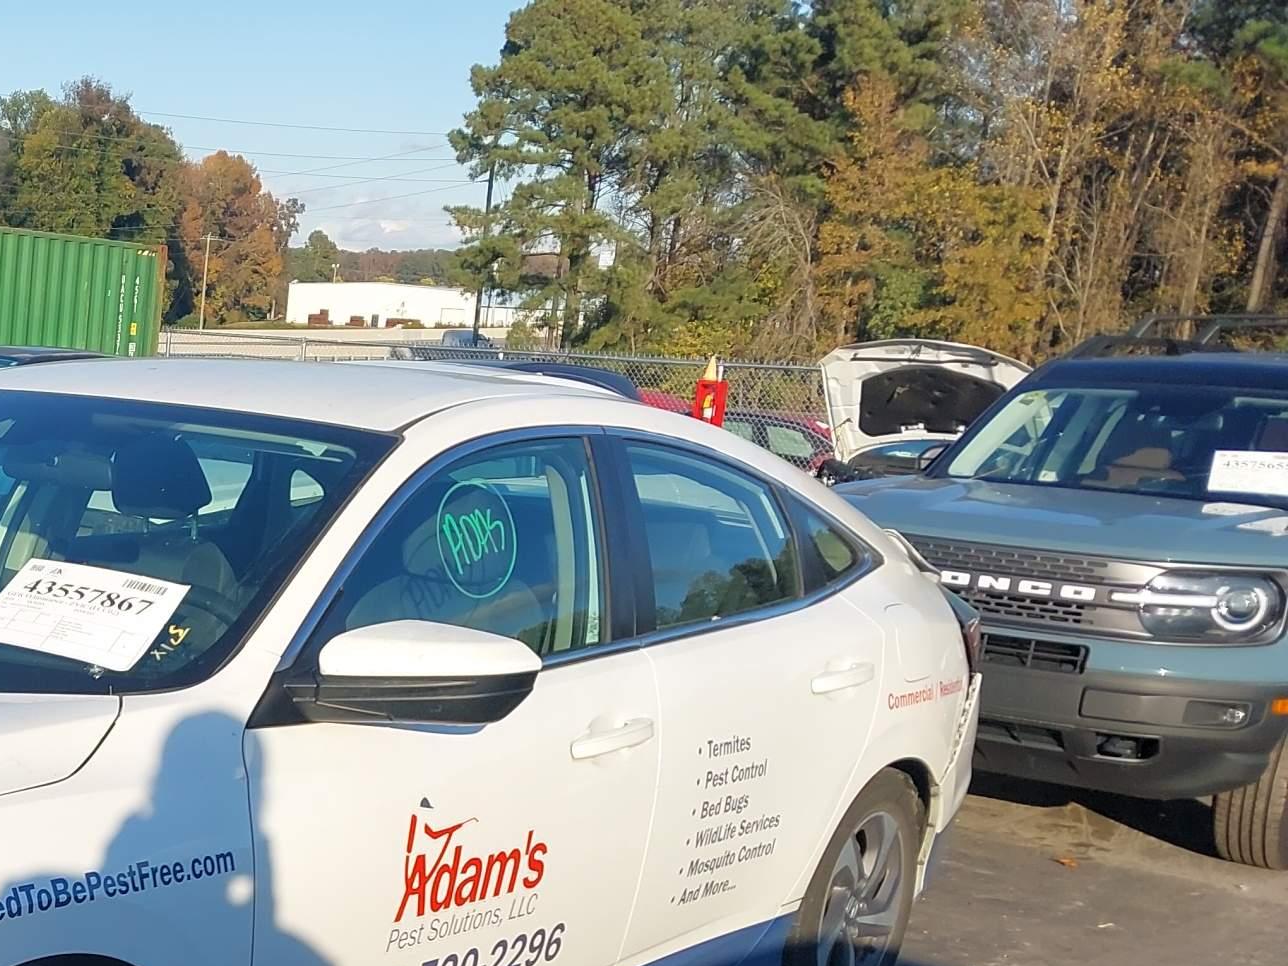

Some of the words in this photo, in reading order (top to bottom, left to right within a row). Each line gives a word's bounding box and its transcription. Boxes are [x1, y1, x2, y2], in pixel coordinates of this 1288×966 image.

[24, 578, 154, 615] 43557867
[940, 570, 1097, 601] ONCO
[888, 685, 934, 711] Commercial
[707, 735, 751, 759] Termites
[705, 769, 728, 789] Pest
[731, 758, 768, 781] Control
[701, 797, 722, 819] Bed
[724, 792, 749, 815] Bugs
[694, 821, 736, 849] WildLife
[738, 812, 780, 838] Services
[686, 852, 735, 878] Mosquito
[737, 839, 776, 863] Control
[394, 828, 548, 923] Adam's
[678, 885, 701, 906] And
[702, 877, 737, 897] More...
[386, 925, 424, 952] Pest
[427, 907, 503, 943] Solutions,
[508, 893, 539, 921] LLC
